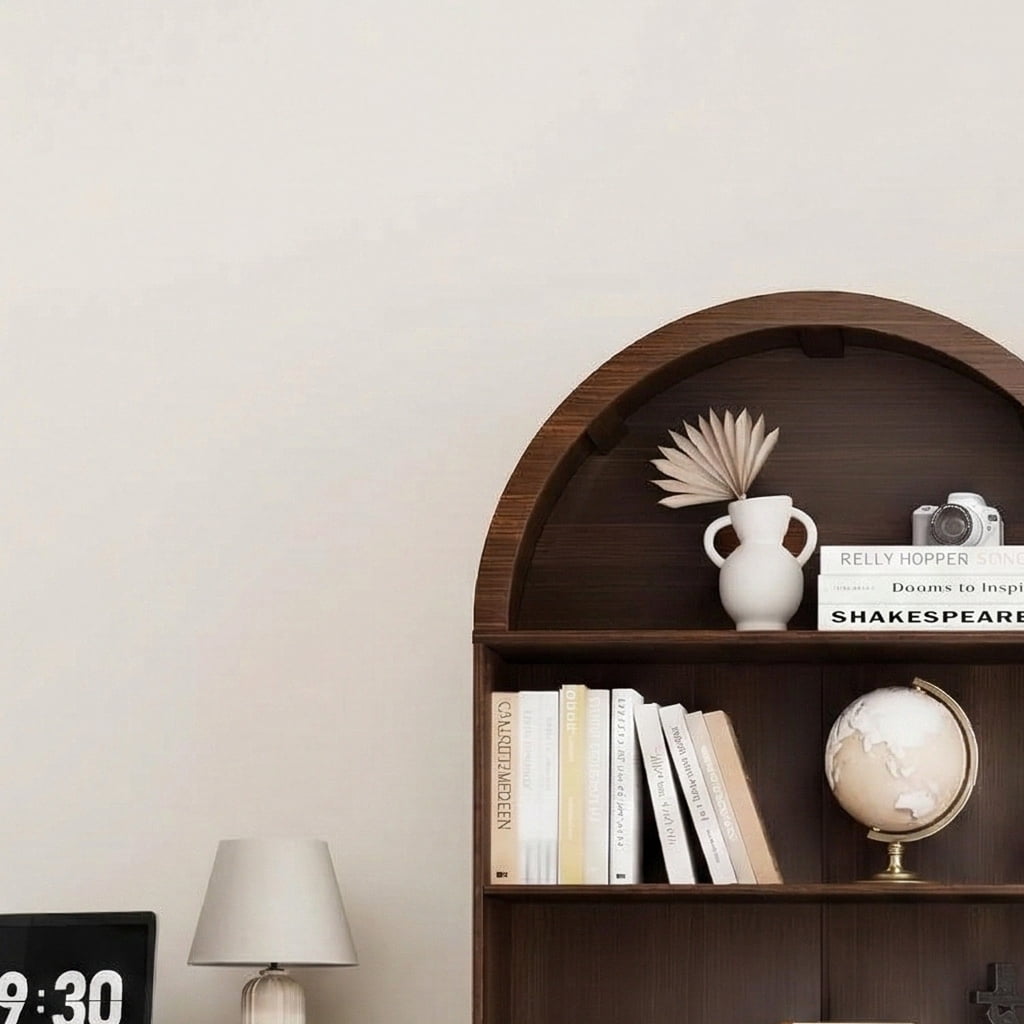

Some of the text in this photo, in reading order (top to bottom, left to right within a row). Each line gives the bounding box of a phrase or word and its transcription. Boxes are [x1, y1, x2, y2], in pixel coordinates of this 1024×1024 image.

[841, 552, 893, 566] RELLY
[900, 552, 969, 566] HOPPER
[959, 583, 975, 593] to
